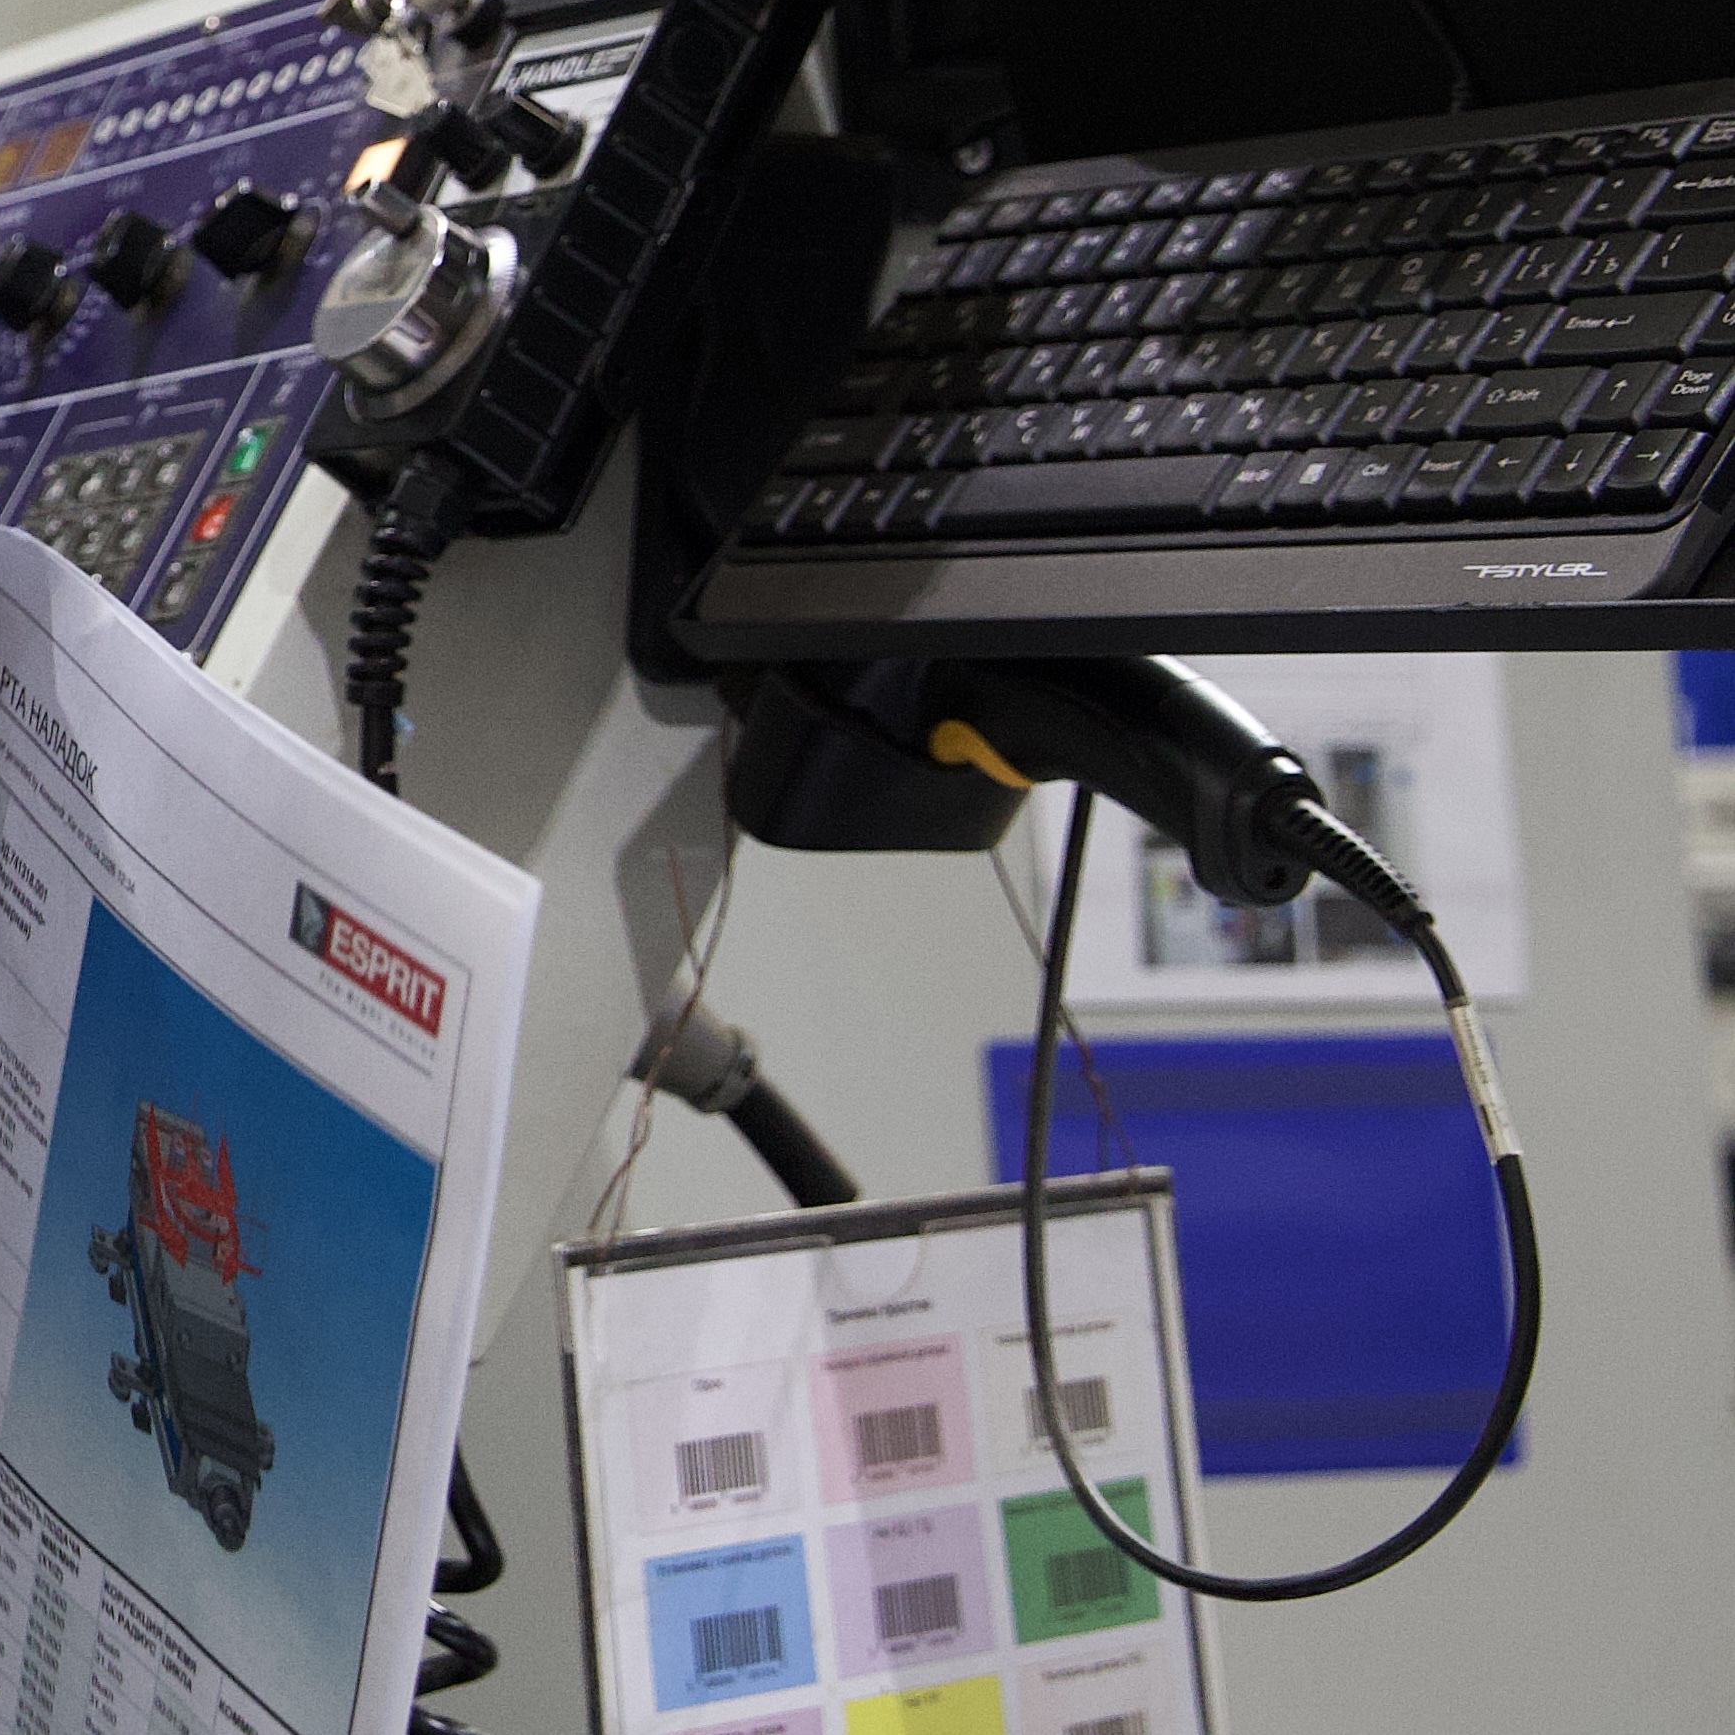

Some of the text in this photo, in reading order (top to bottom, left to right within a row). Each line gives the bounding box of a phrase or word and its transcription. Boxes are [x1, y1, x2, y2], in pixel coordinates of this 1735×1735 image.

[1564, 316, 1605, 330] Enter
[1506, 388, 1542, 402] Shift
[1670, 383, 1711, 396] Down
[1679, 369, 1715, 384] Page
[29, 696, 98, 794] НАЛАДОК
[329, 916, 441, 1019] ESPRIT
[101, 1600, 157, 1656] НА РАДИУС
[104, 1579, 162, 1642] КОРРЕКЦИЯ
[162, 1655, 192, 1693] ЦИКЛА
[164, 1635, 197, 1675] ВРЕМЯ
